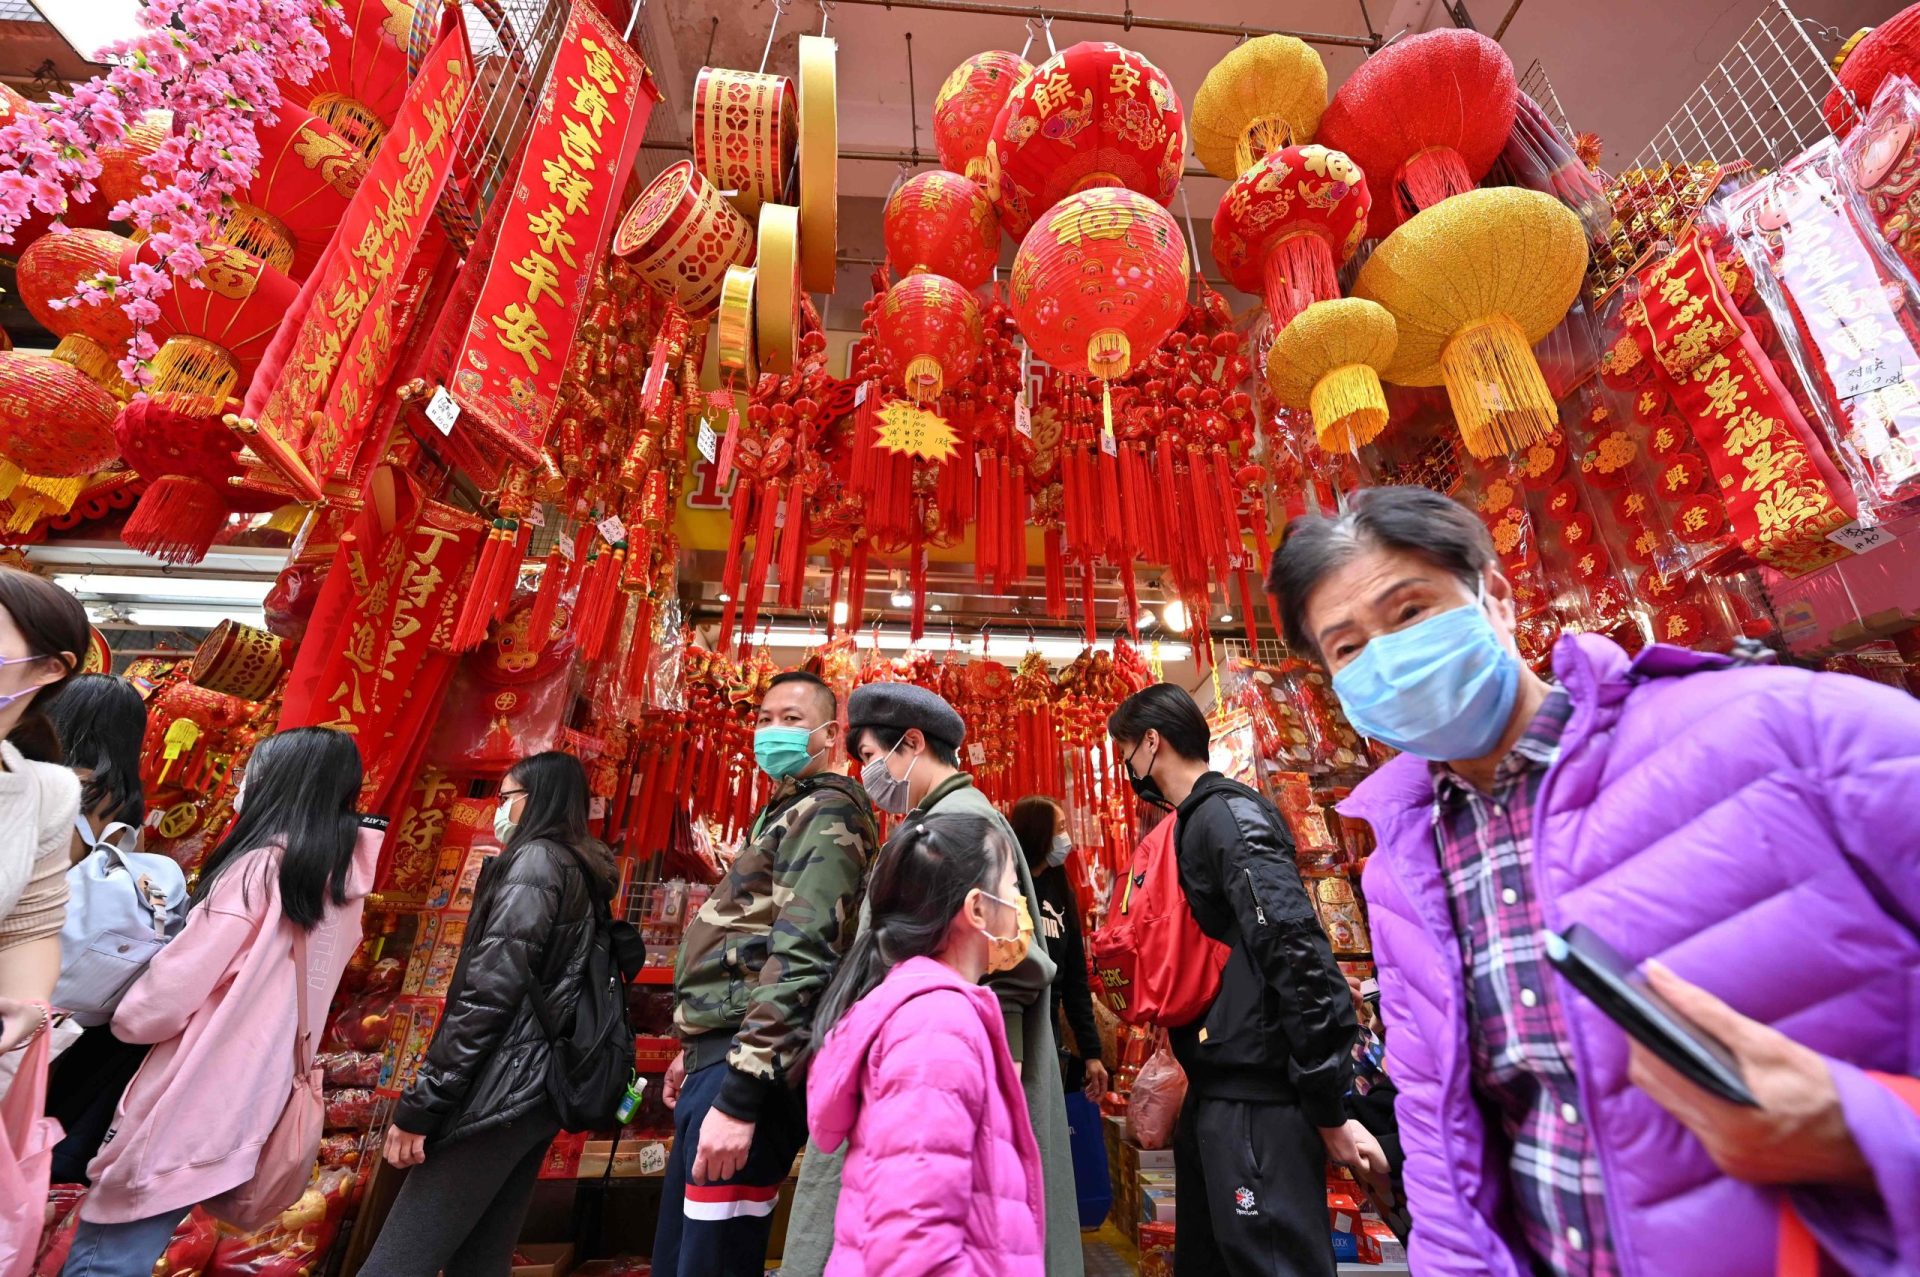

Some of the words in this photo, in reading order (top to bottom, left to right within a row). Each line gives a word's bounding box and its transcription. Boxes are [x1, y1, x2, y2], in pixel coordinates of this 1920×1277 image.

[491, 37, 625, 376] 富貴吉祥永平安
